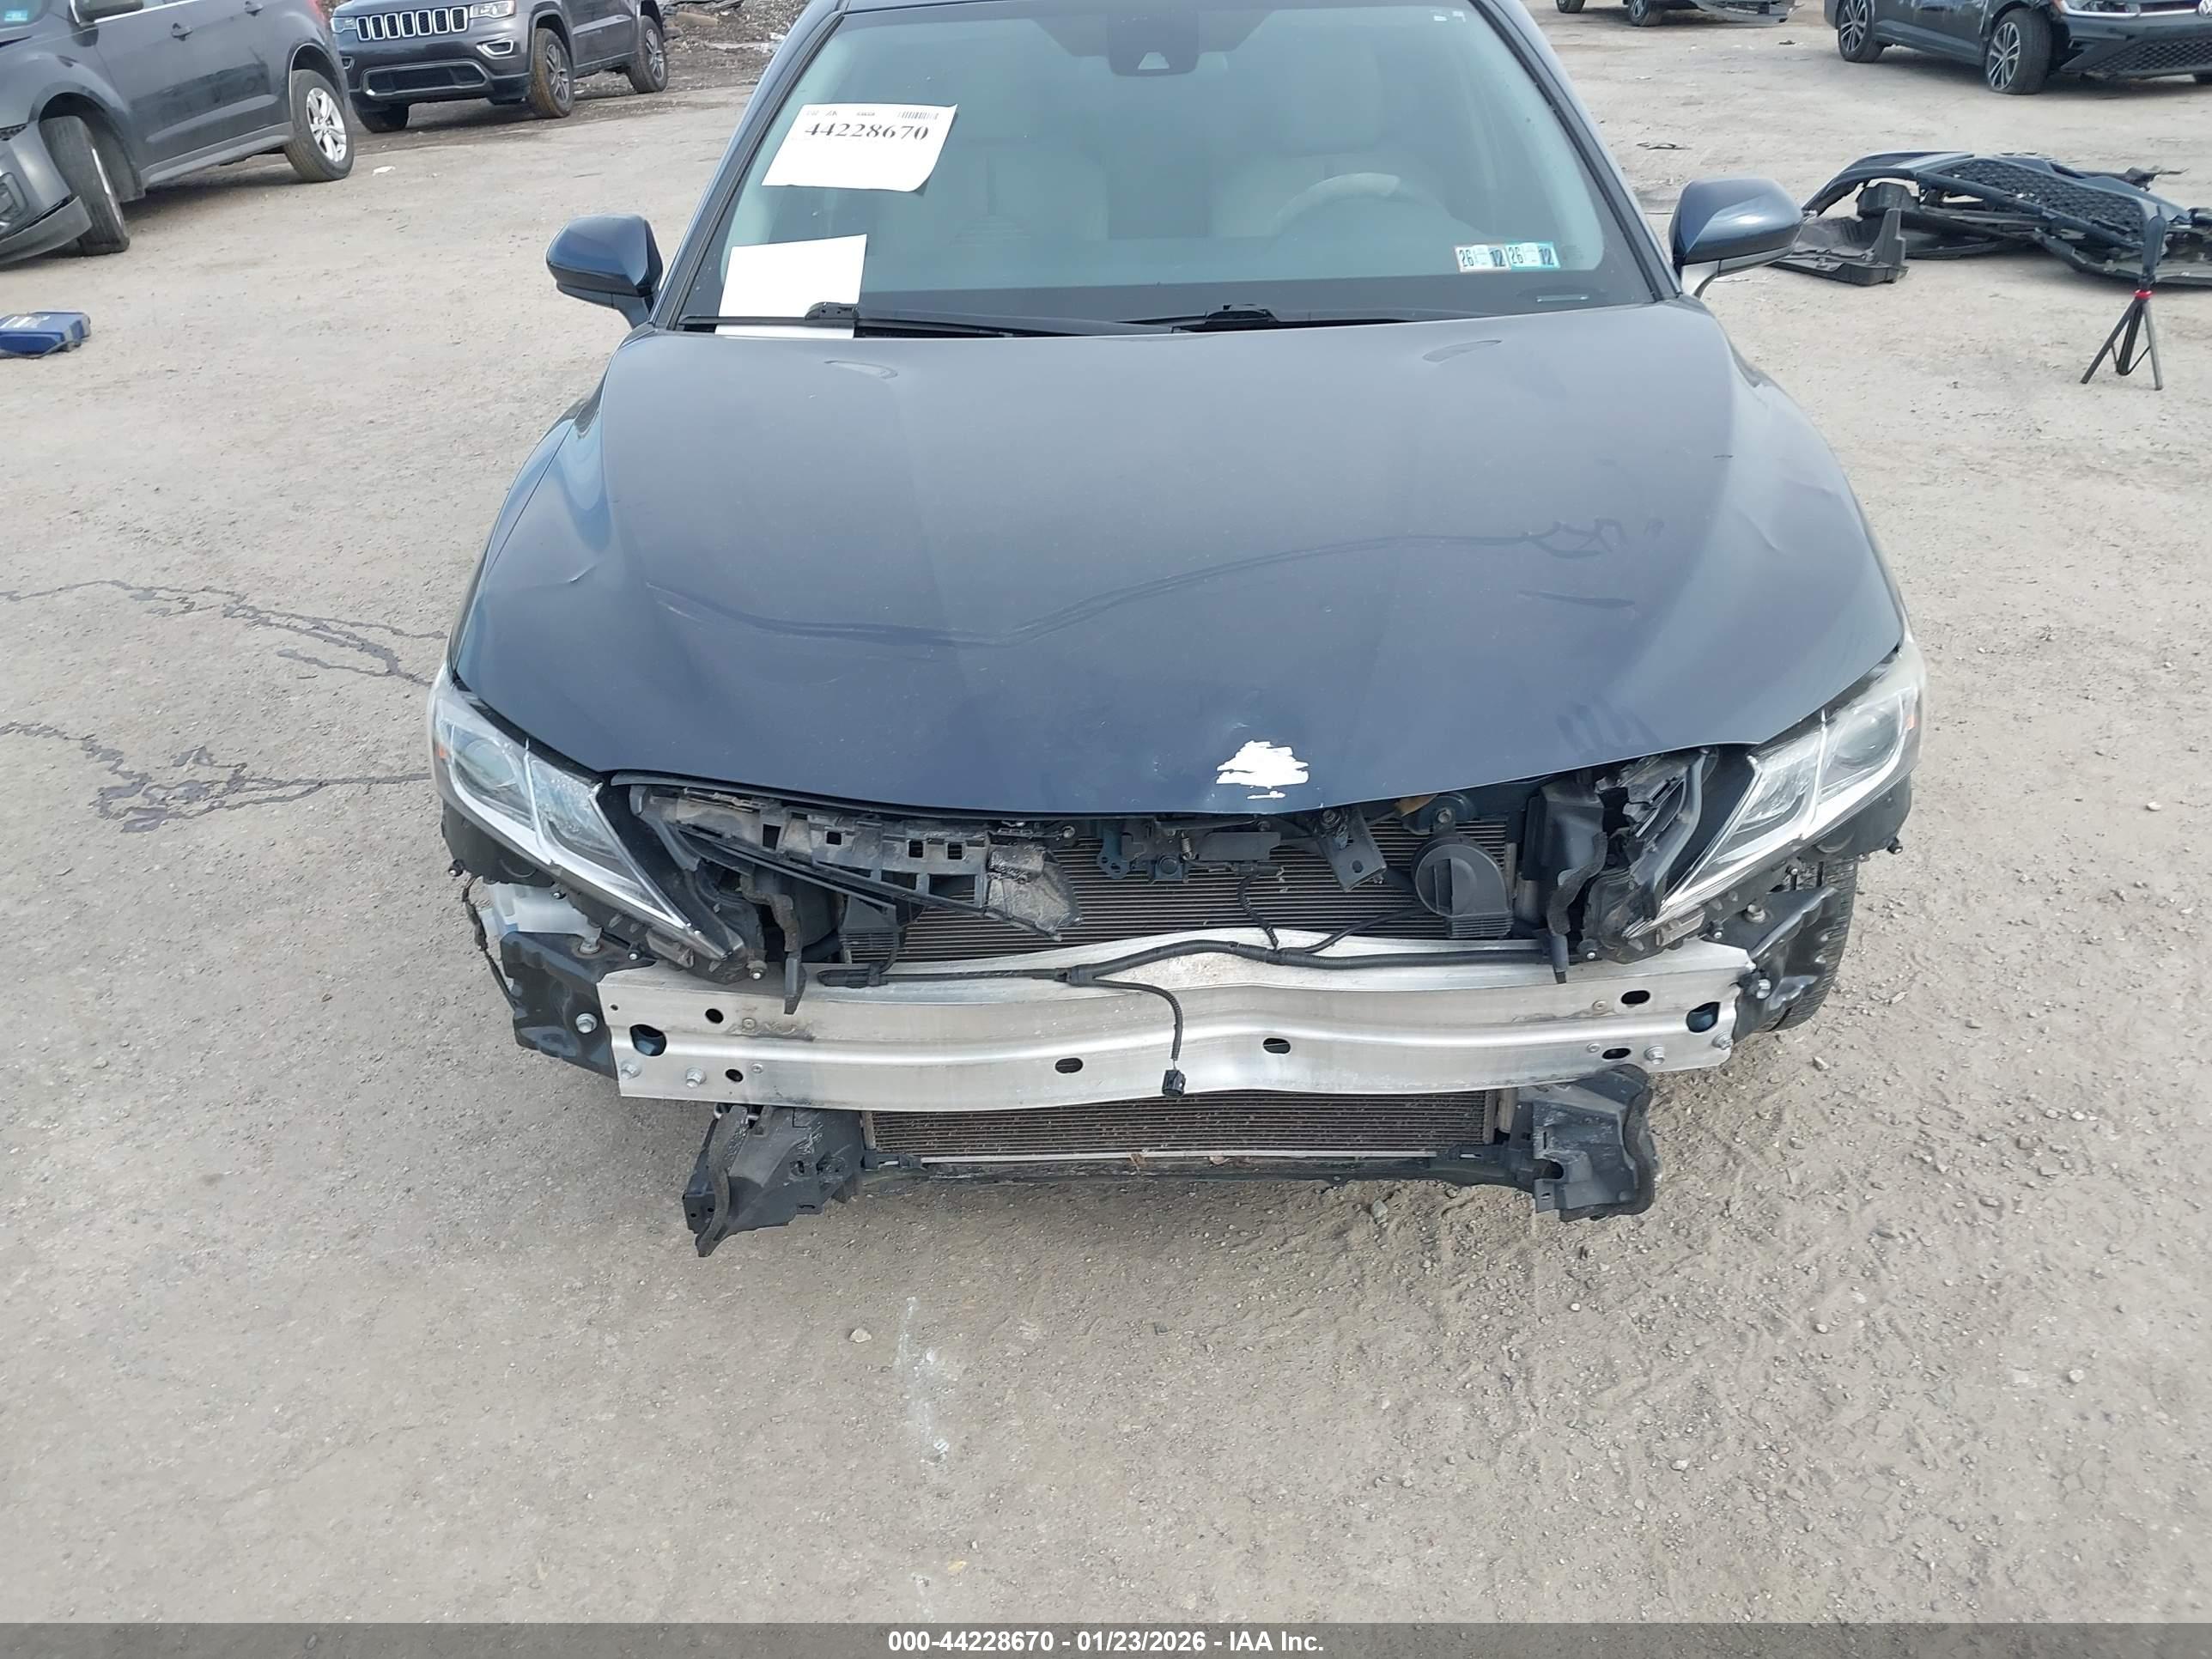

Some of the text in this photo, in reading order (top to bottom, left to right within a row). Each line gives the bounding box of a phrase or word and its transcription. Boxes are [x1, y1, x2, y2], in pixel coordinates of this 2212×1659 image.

[805, 123, 929, 140] 44228670
[1459, 249, 1474, 267] 26
[1490, 249, 1505, 267] 12
[1509, 246, 1523, 264] 26
[1539, 248, 1554, 265] 12
